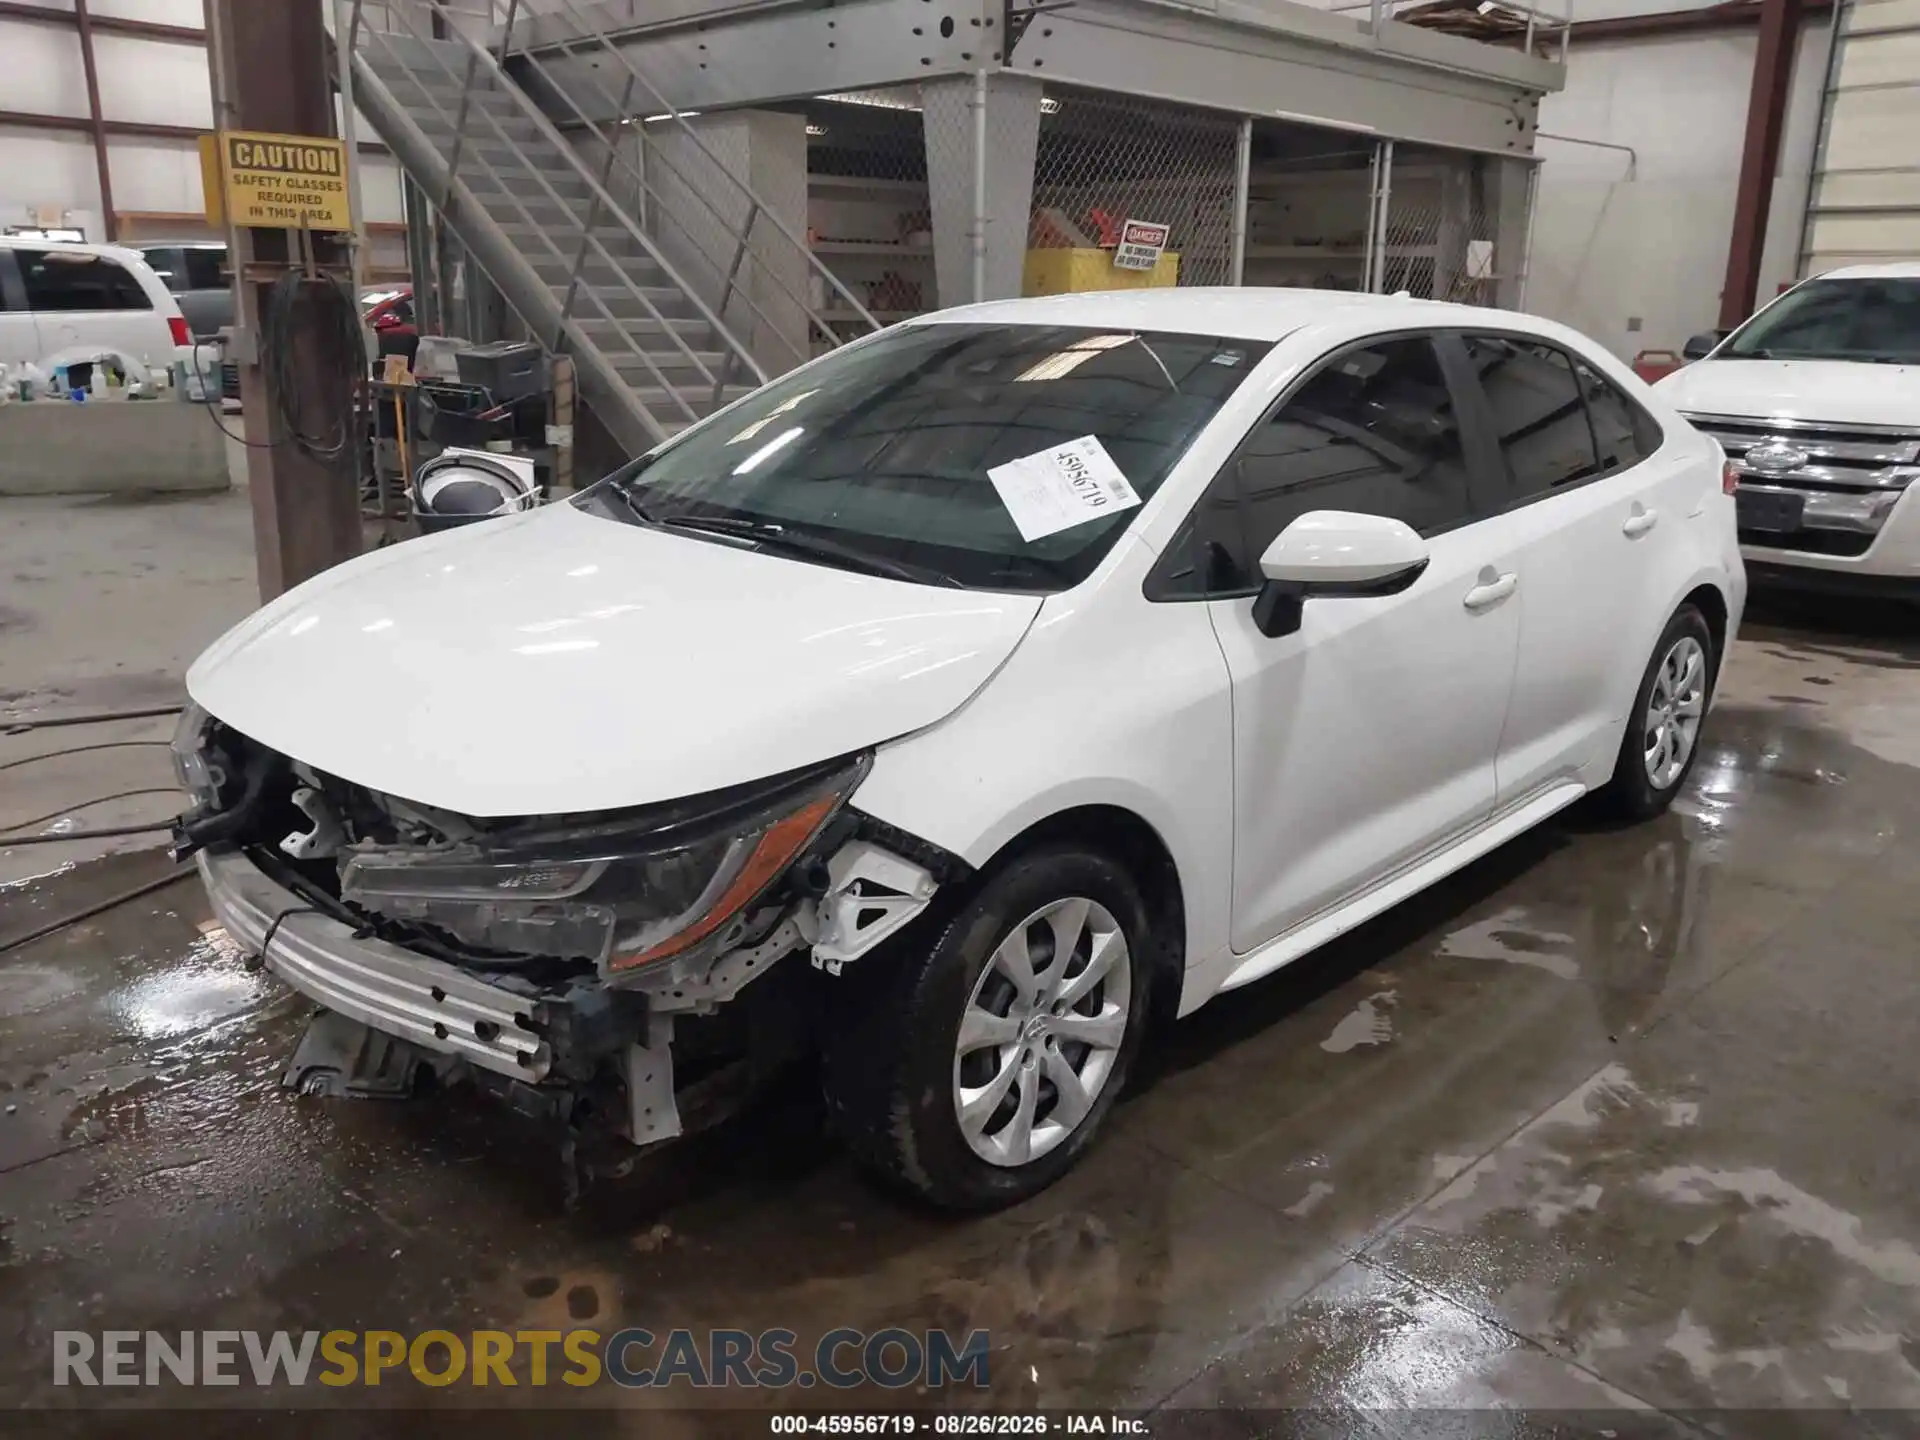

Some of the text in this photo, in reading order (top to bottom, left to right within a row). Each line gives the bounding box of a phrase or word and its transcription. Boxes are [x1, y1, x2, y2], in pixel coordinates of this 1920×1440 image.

[236, 143, 336, 172] CAUTION
[233, 173, 343, 192] SAFETY GLASSES
[257, 191, 323, 205] REQUIRED
[249, 205, 264, 217] IN
[266, 206, 297, 219] THIS
[1056, 452, 1108, 507] 45956719
